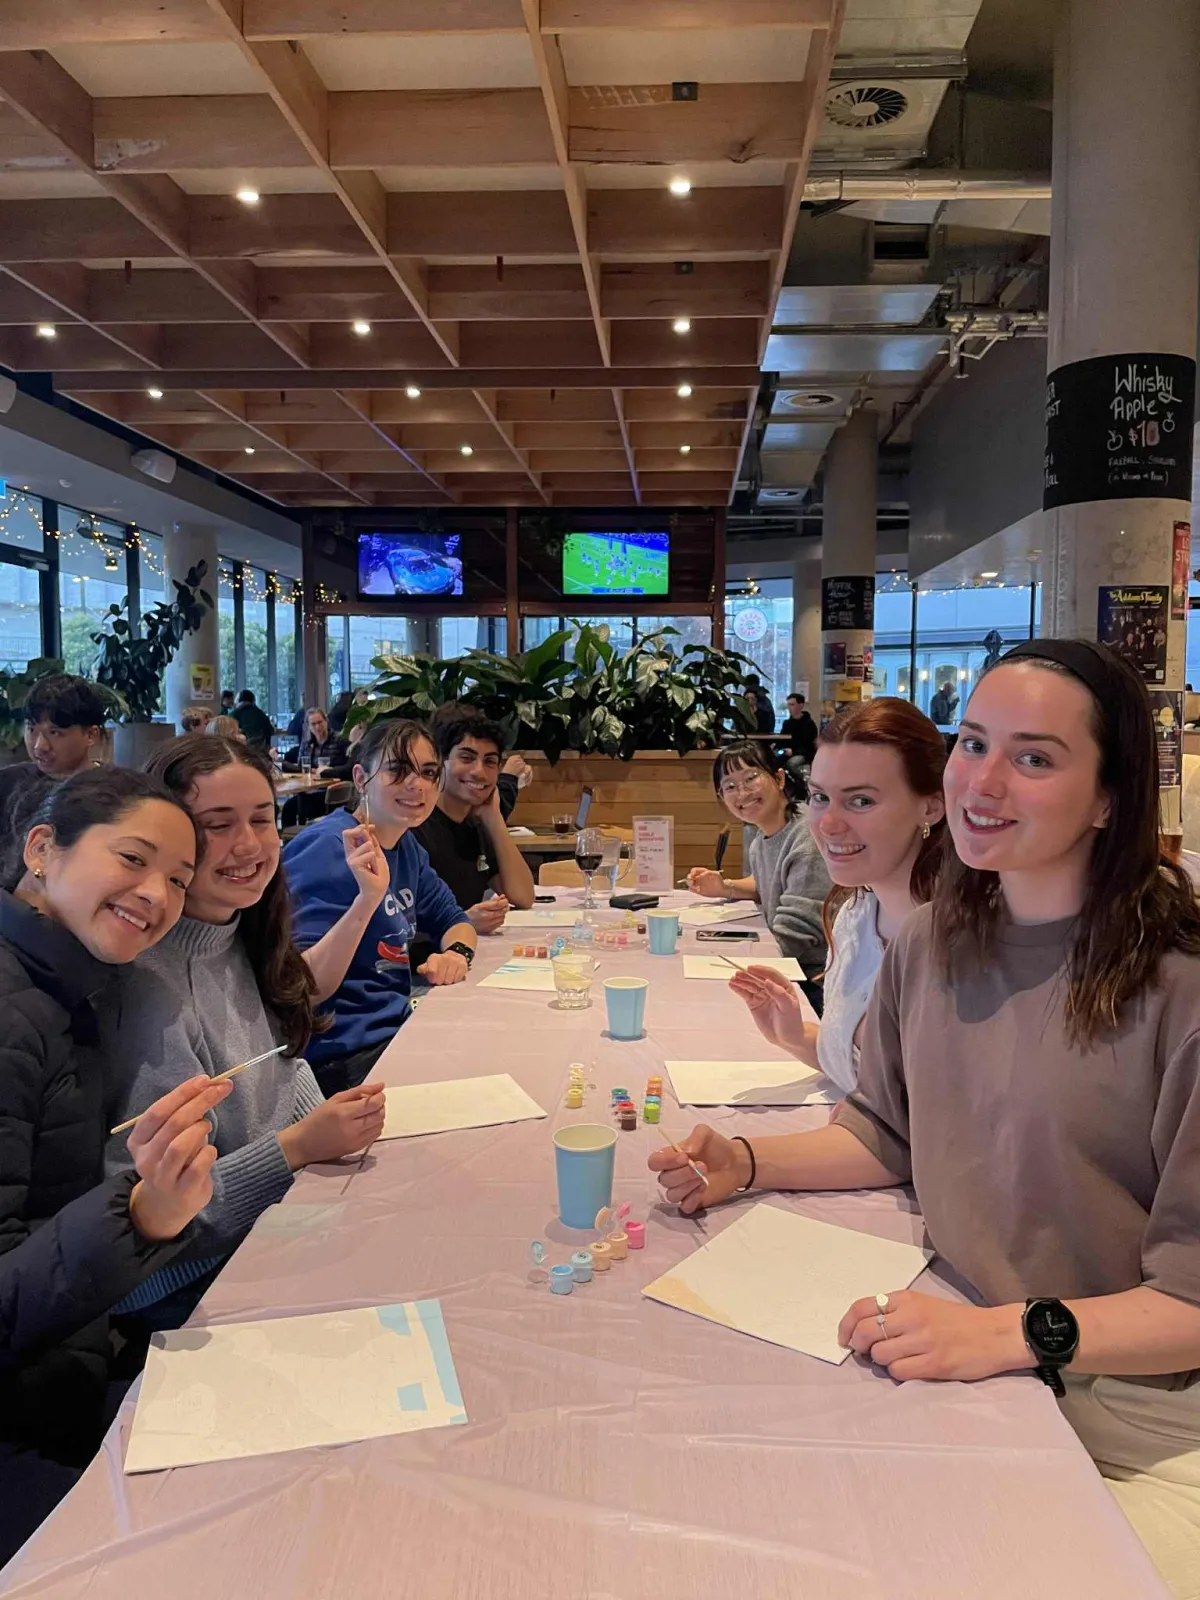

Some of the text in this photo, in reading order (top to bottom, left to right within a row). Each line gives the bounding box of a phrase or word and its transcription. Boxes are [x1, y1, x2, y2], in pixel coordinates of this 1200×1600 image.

[1115, 364, 1182, 403] Whisky
[1110, 394, 1159, 421] Apple
[1128, 420, 1160, 447] $10
